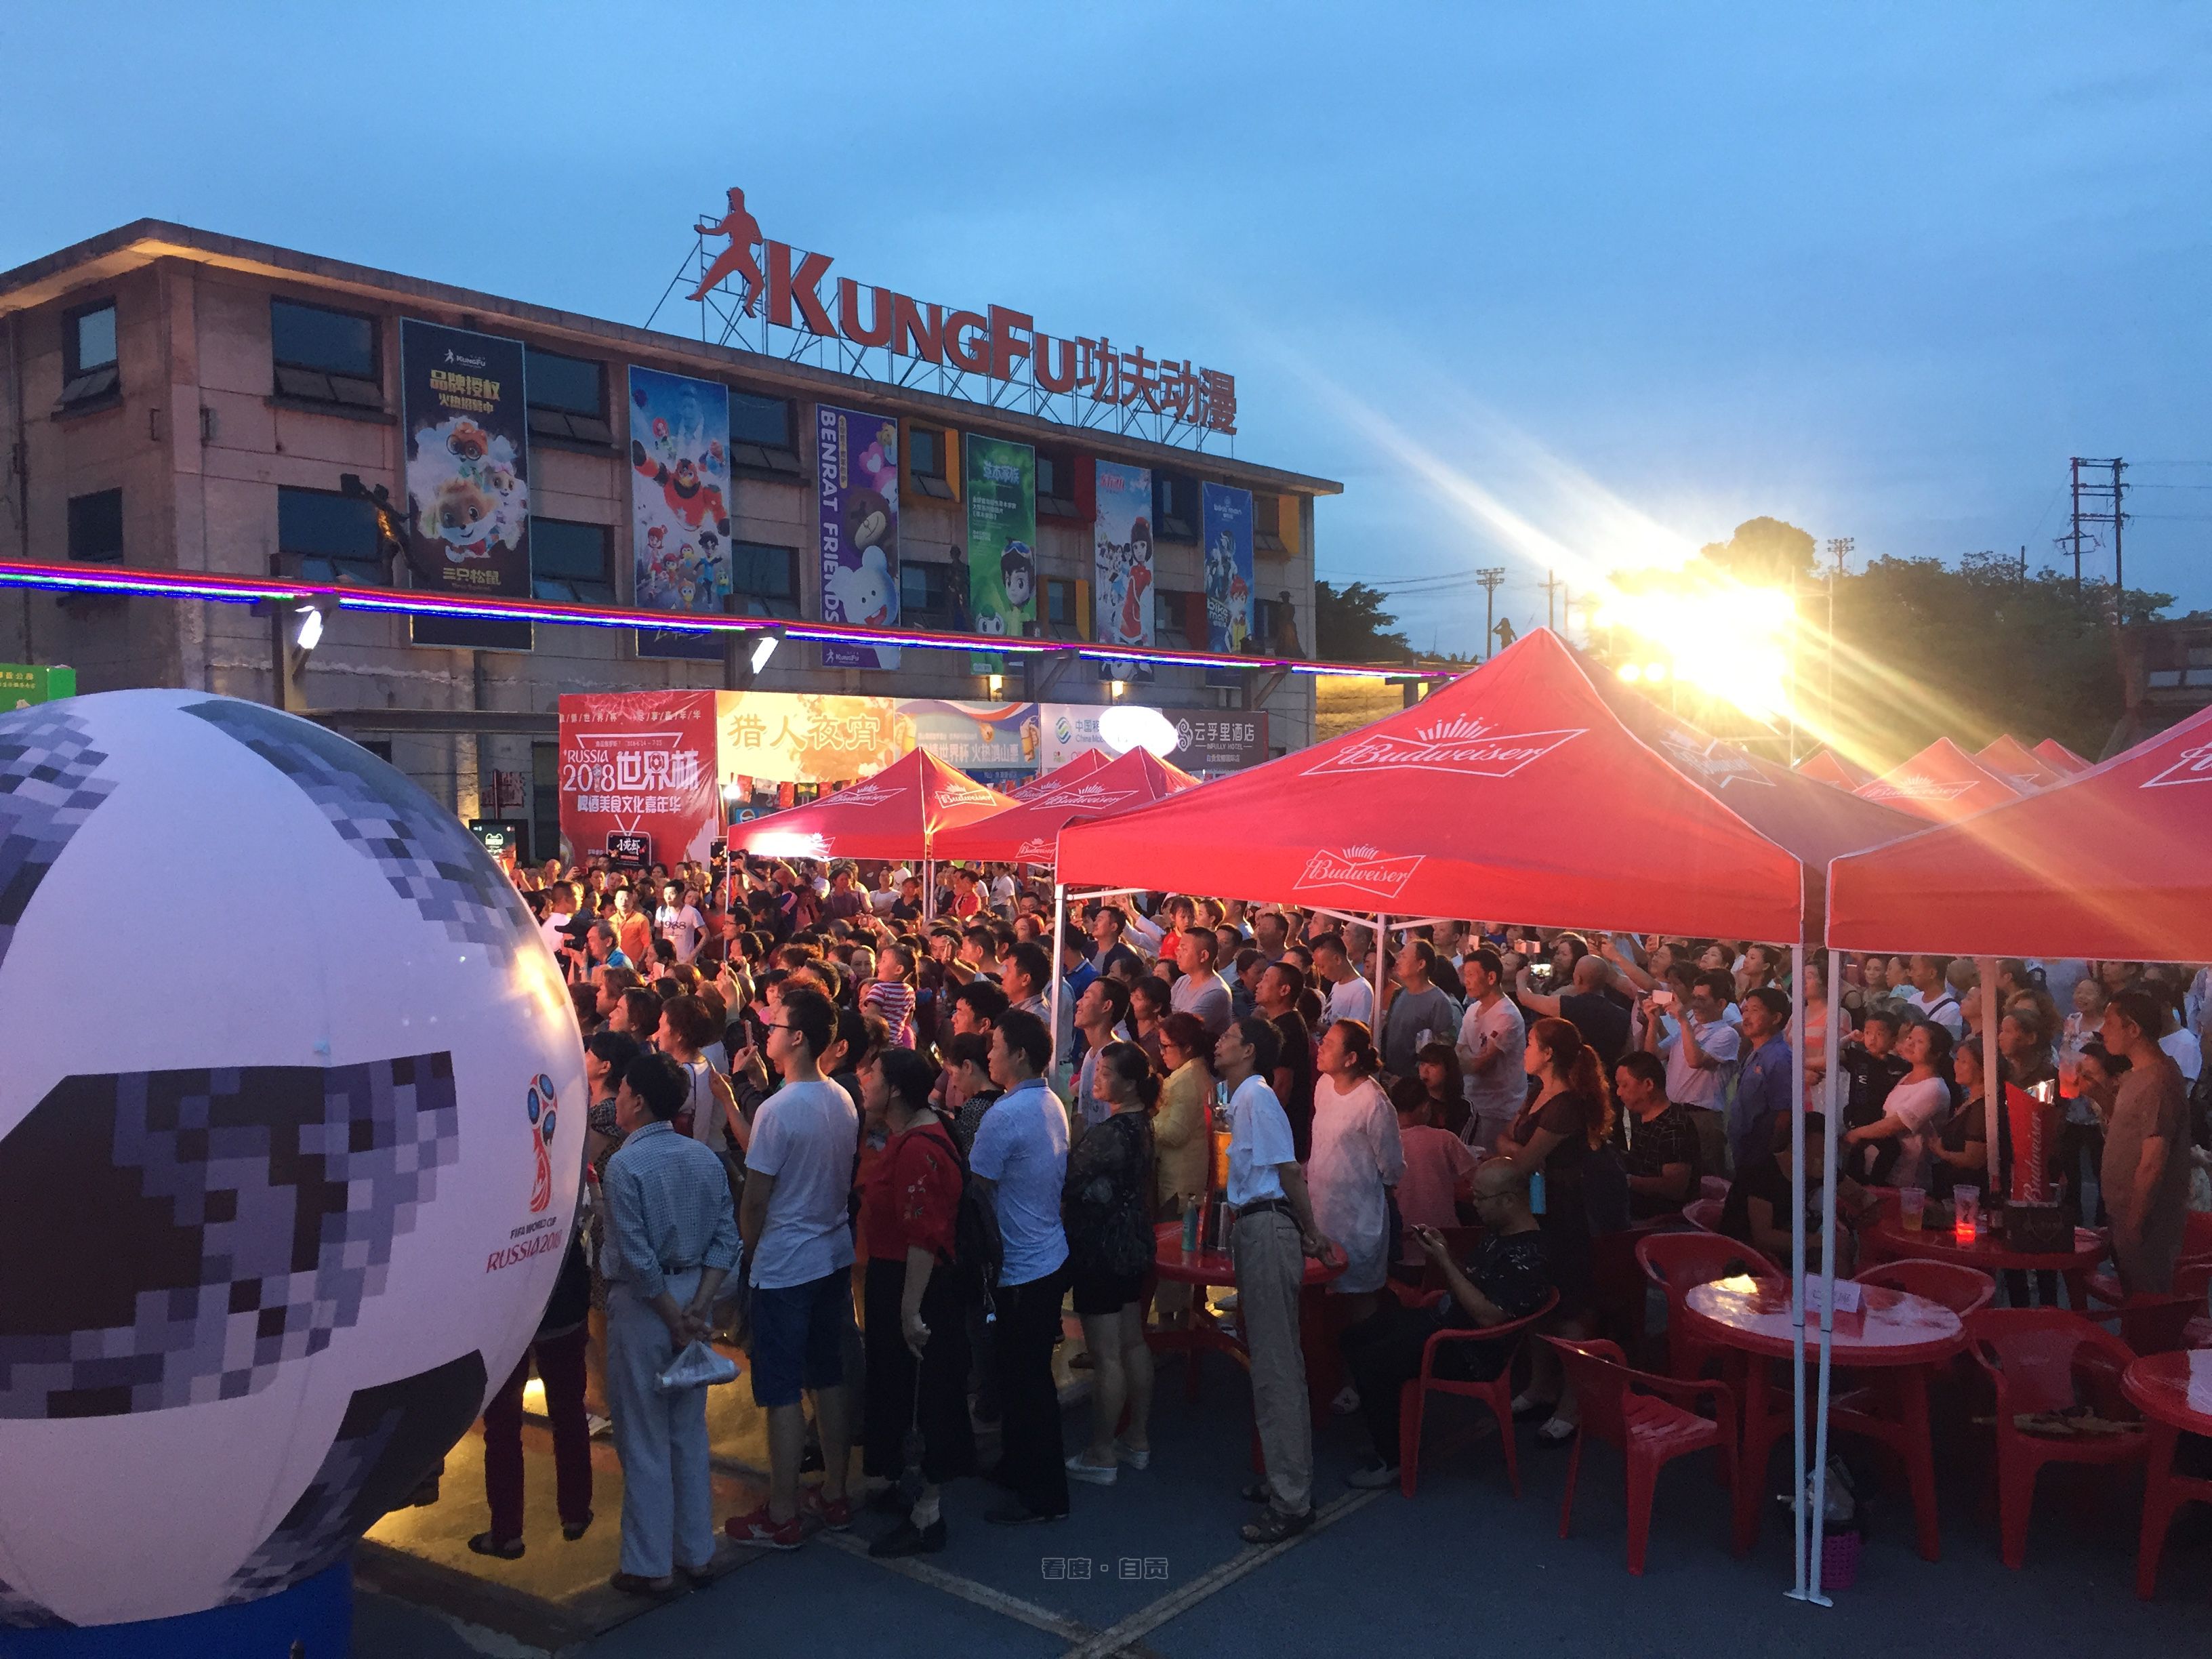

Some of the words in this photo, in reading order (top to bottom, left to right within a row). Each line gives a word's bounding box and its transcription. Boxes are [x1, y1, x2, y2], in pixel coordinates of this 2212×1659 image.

[430, 369, 501, 401] 品牌授权
[1076, 336, 1238, 436] 功夫动漫
[821, 410, 838, 512] BENRAT
[443, 567, 501, 586] 三只松鼠
[823, 522, 840, 623] FRIENDS
[1207, 596, 1228, 616] bike
[726, 713, 881, 752] 猎人夜宵
[1195, 722, 1254, 742] 云孚里酒店
[1336, 741, 1546, 766] Budweiser
[617, 747, 700, 792] 世界杯
[577, 794, 682, 814] 啤酒美食文化嘉年华
[616, 838, 641, 856] 小龙虾
[1305, 858, 1410, 884] Budweiser
[510, 1226, 526, 1240] FIFA
[526, 1218, 545, 1235] WORLD
[545, 1216, 557, 1228] CUP
